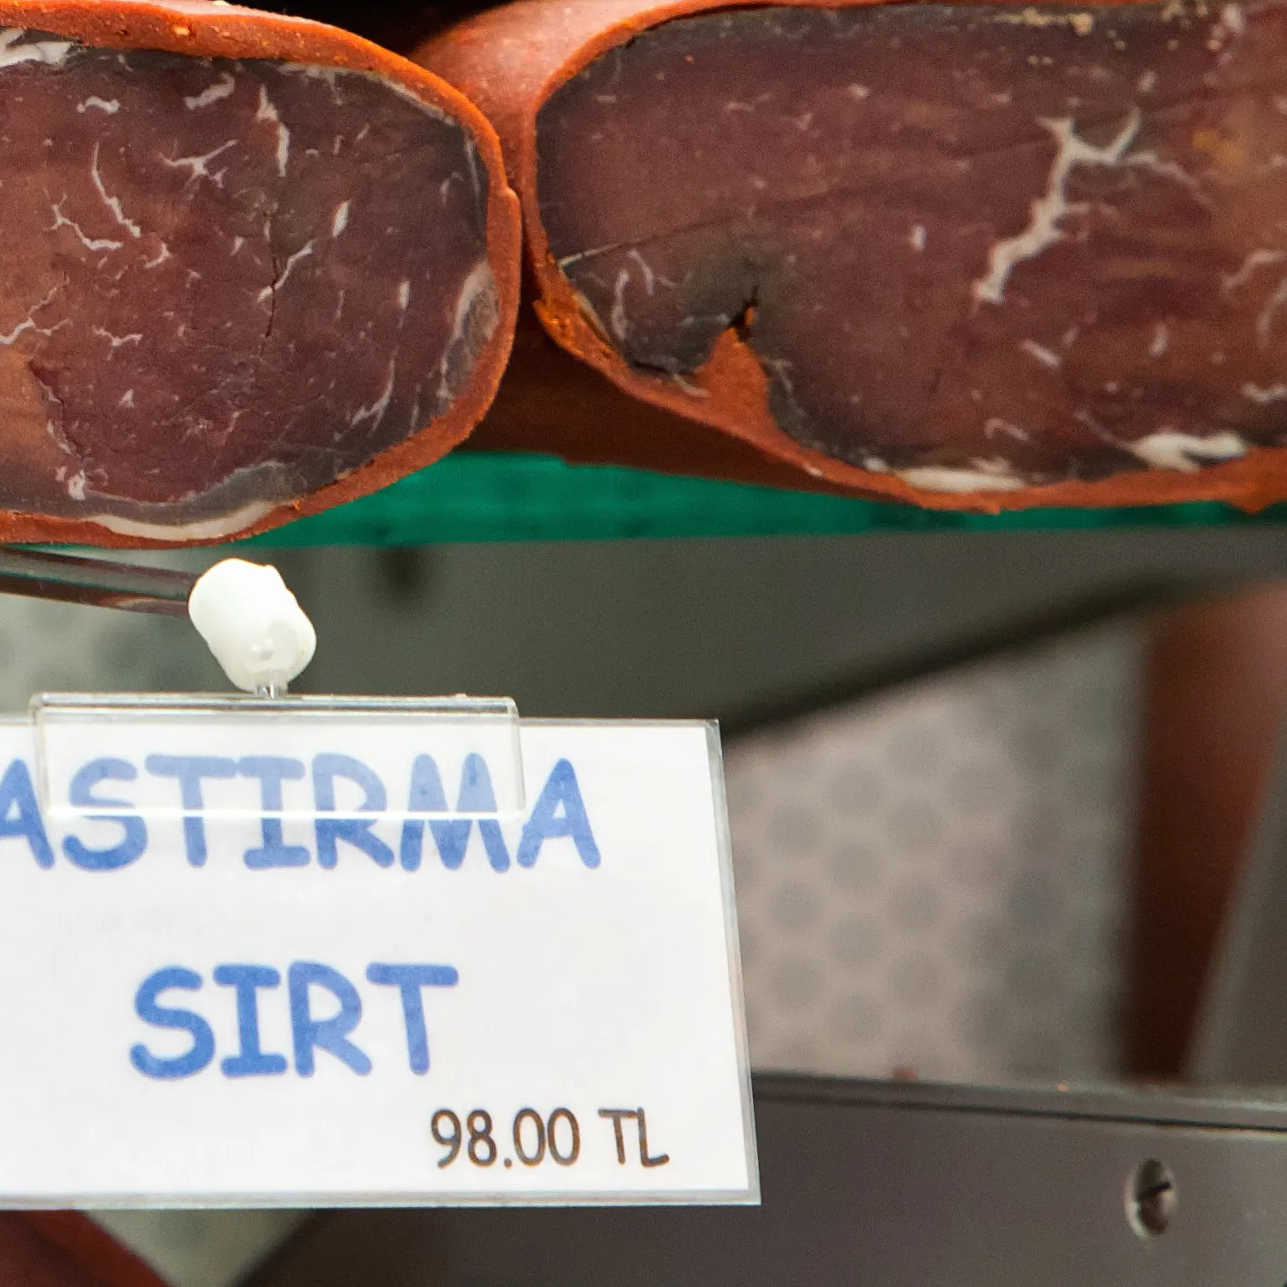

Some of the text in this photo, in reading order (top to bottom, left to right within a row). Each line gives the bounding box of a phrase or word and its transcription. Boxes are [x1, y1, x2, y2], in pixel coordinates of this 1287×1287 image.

[128, 961, 460, 1079] SIRT
[430, 1107, 670, 1168] 98.00 TL
